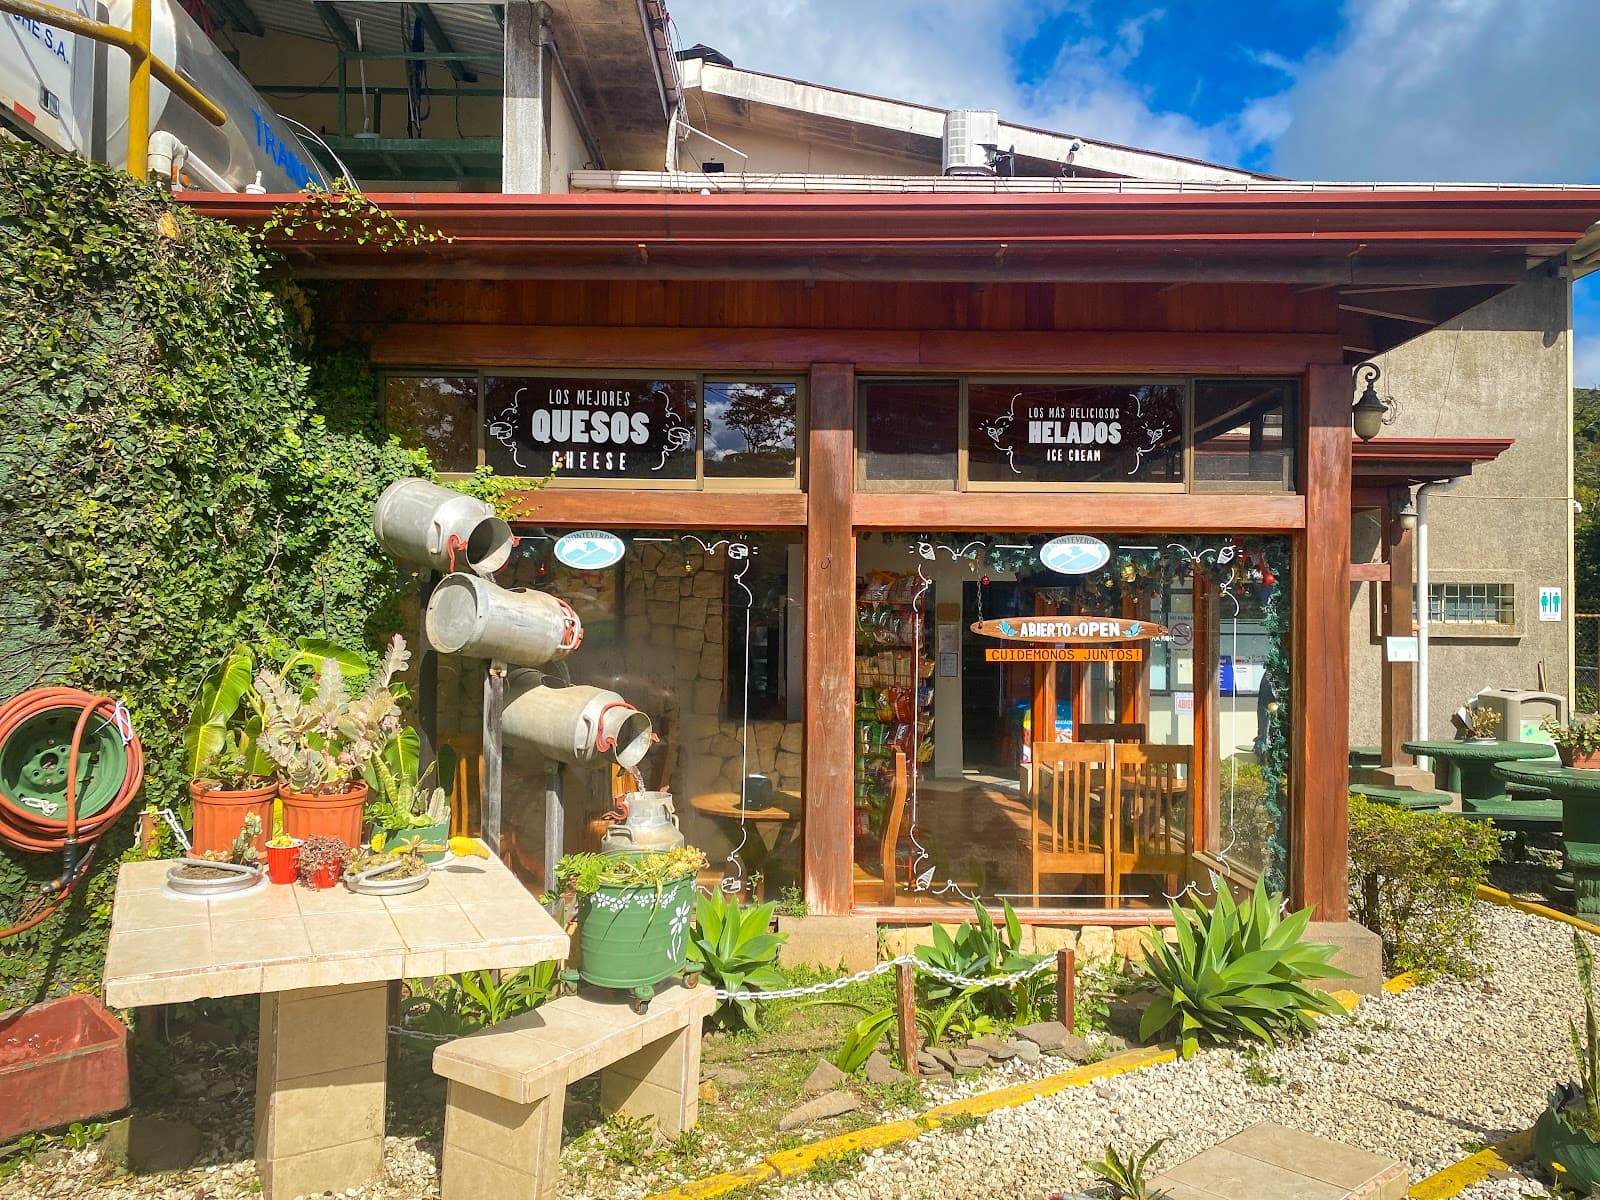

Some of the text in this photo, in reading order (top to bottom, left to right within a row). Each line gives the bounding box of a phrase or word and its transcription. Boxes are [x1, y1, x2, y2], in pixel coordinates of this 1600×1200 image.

[44, 28, 69, 64] S.A.
[549, 388, 631, 407] LOS MEJORES
[1028, 405, 1120, 419] LOS MÁS DELICIOSOS
[531, 408, 650, 445] QUESOS
[1028, 420, 1122, 445] HELADOS
[552, 450, 627, 471] CHEESE
[1046, 448, 1101, 462] ICE CREAM
[1019, 621, 1121, 638] ABIERTO OPEN
[991, 649, 1140, 661] CUIDEMONOS JUNTOS!
